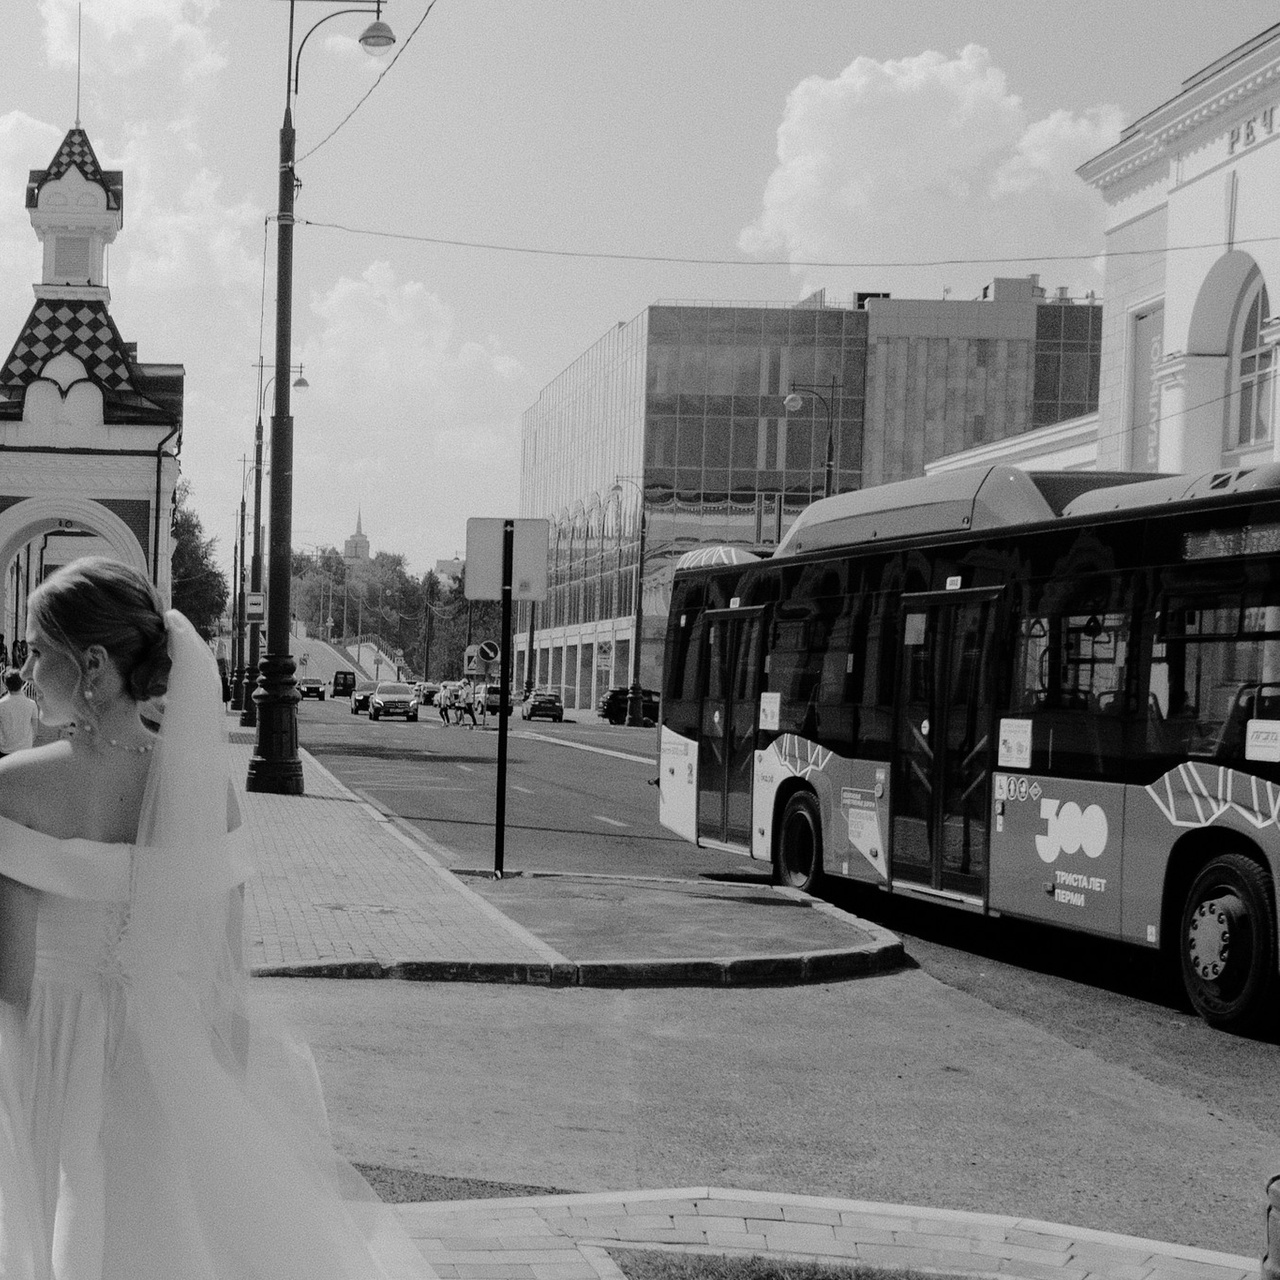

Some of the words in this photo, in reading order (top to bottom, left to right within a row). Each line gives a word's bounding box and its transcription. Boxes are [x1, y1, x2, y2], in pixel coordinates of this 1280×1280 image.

[1035, 798, 1108, 863] 300
[1055, 870, 1088, 888] ТРИСТА
[1088, 876, 1107, 892] ЛЕТ
[1054, 888, 1085, 907] ПЕРМИ
